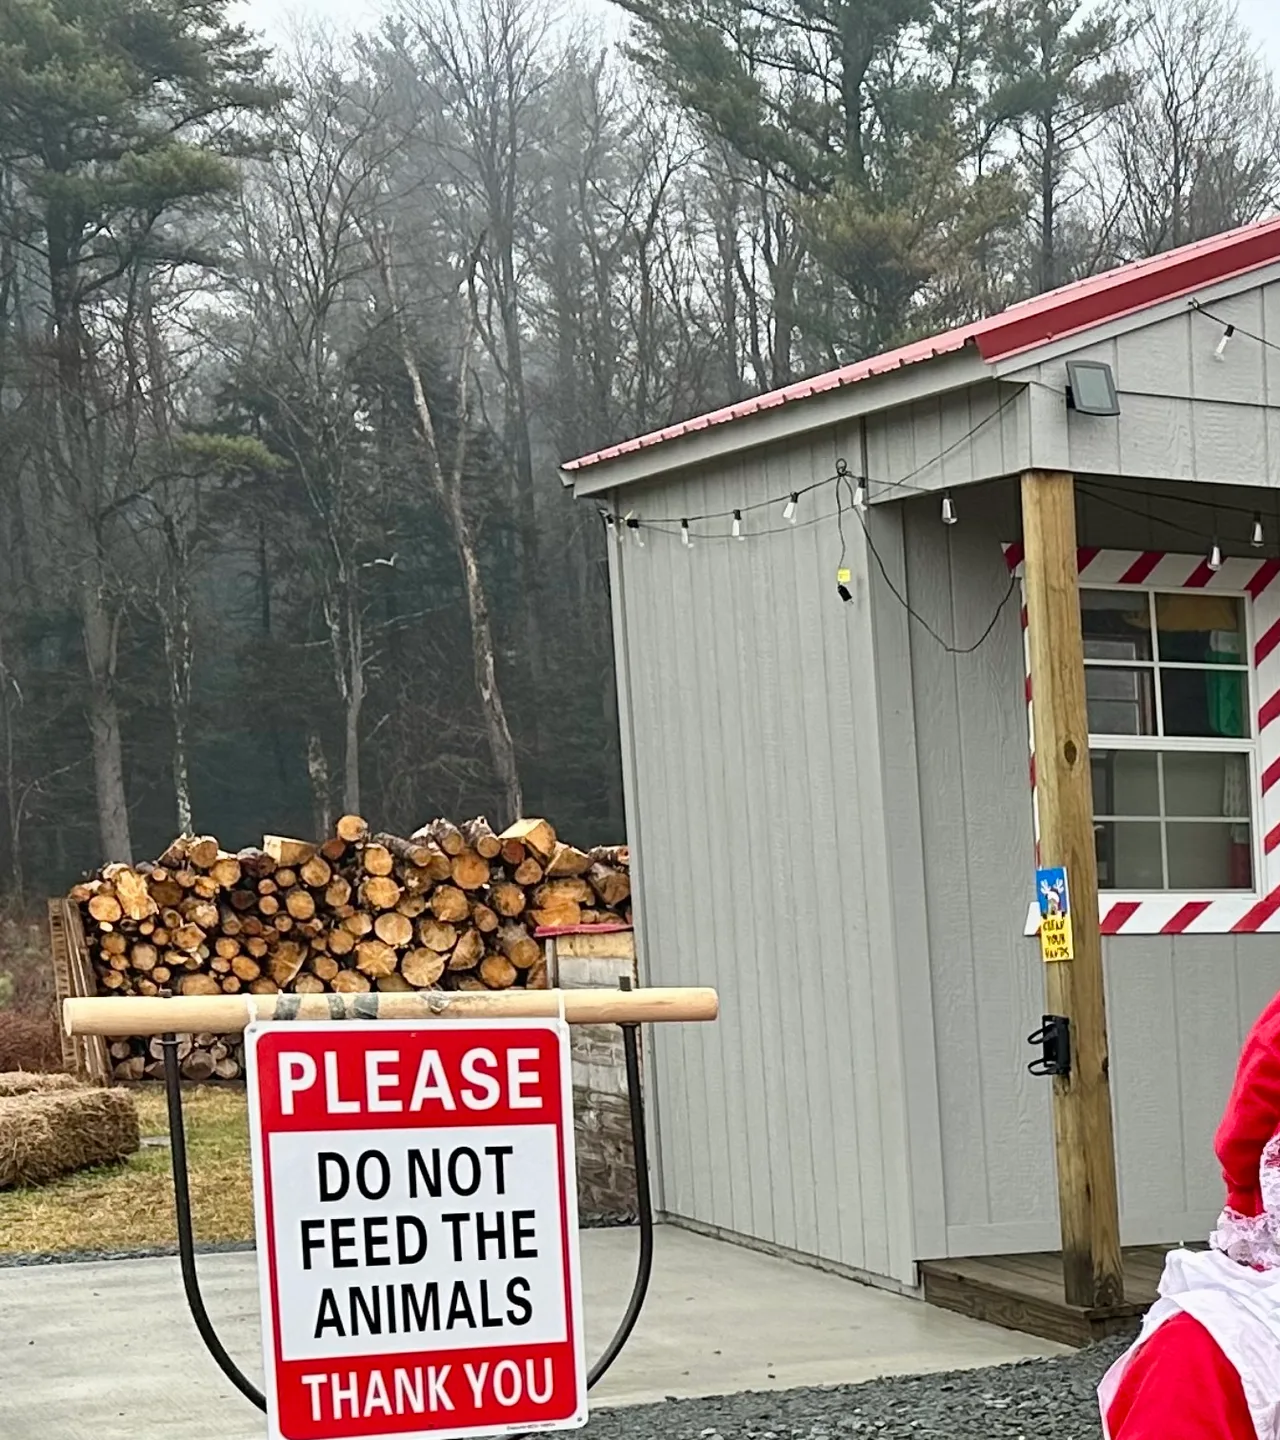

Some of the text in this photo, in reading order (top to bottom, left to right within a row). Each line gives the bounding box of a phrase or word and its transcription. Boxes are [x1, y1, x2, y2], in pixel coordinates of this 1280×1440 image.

[278, 1047, 543, 1115] PLEASE
[317, 1145, 514, 1203] DO NOT
[300, 1209, 538, 1270] FEED THE
[313, 1276, 533, 1339] ANIMALS
[301, 1357, 554, 1421] THANK YOU
